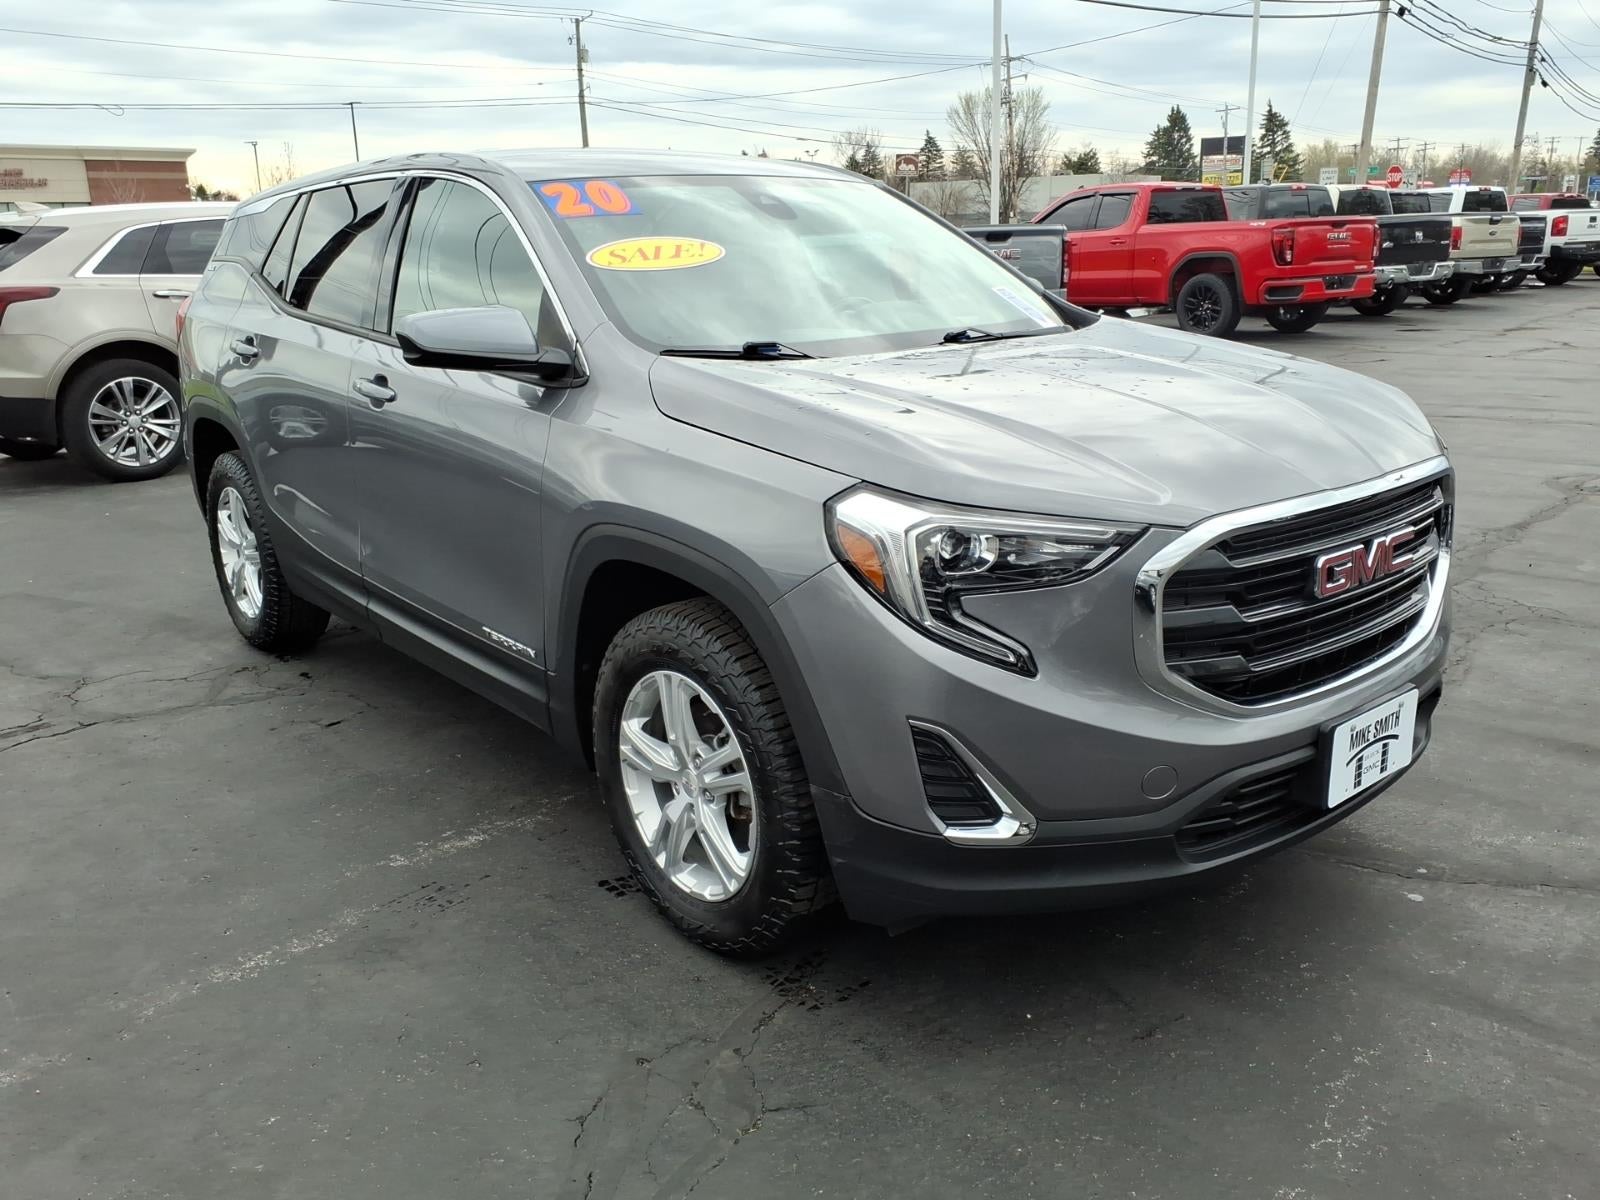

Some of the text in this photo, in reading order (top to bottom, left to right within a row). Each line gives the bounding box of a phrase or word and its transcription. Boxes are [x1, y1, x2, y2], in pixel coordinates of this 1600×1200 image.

[1387, 172, 1403, 183] STOP
[540, 180, 632, 217] 20
[607, 242, 706, 267] SALE!
[992, 248, 1022, 260] MC
[1314, 525, 1416, 599] GMC
[1349, 709, 1401, 753] MIKE SMITH
